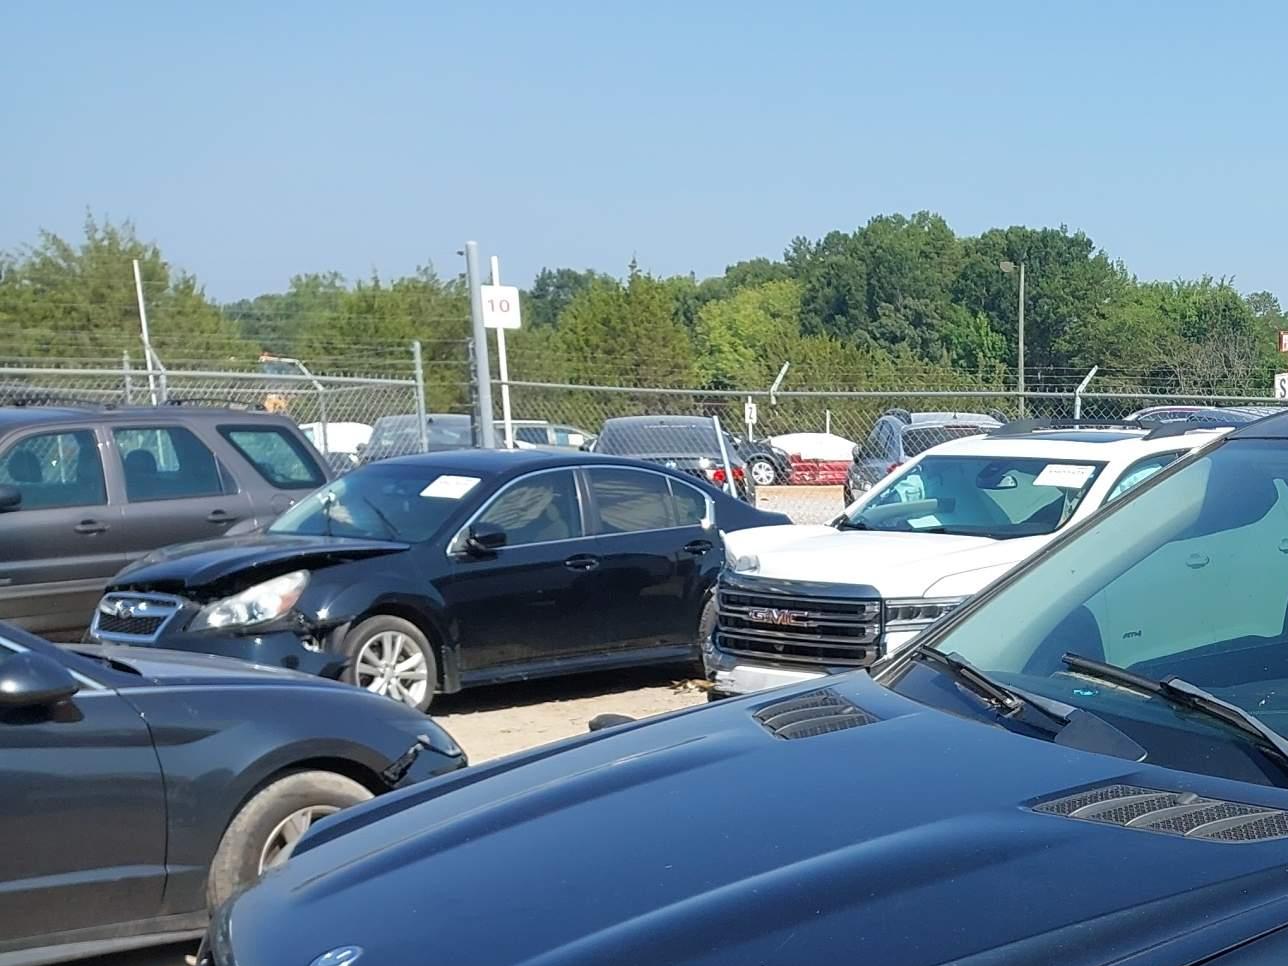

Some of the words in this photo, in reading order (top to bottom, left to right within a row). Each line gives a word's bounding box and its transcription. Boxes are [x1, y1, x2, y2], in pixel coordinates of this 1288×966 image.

[487, 299, 510, 313] 10
[1279, 377, 1287, 398] S
[748, 608, 809, 627] GMC
